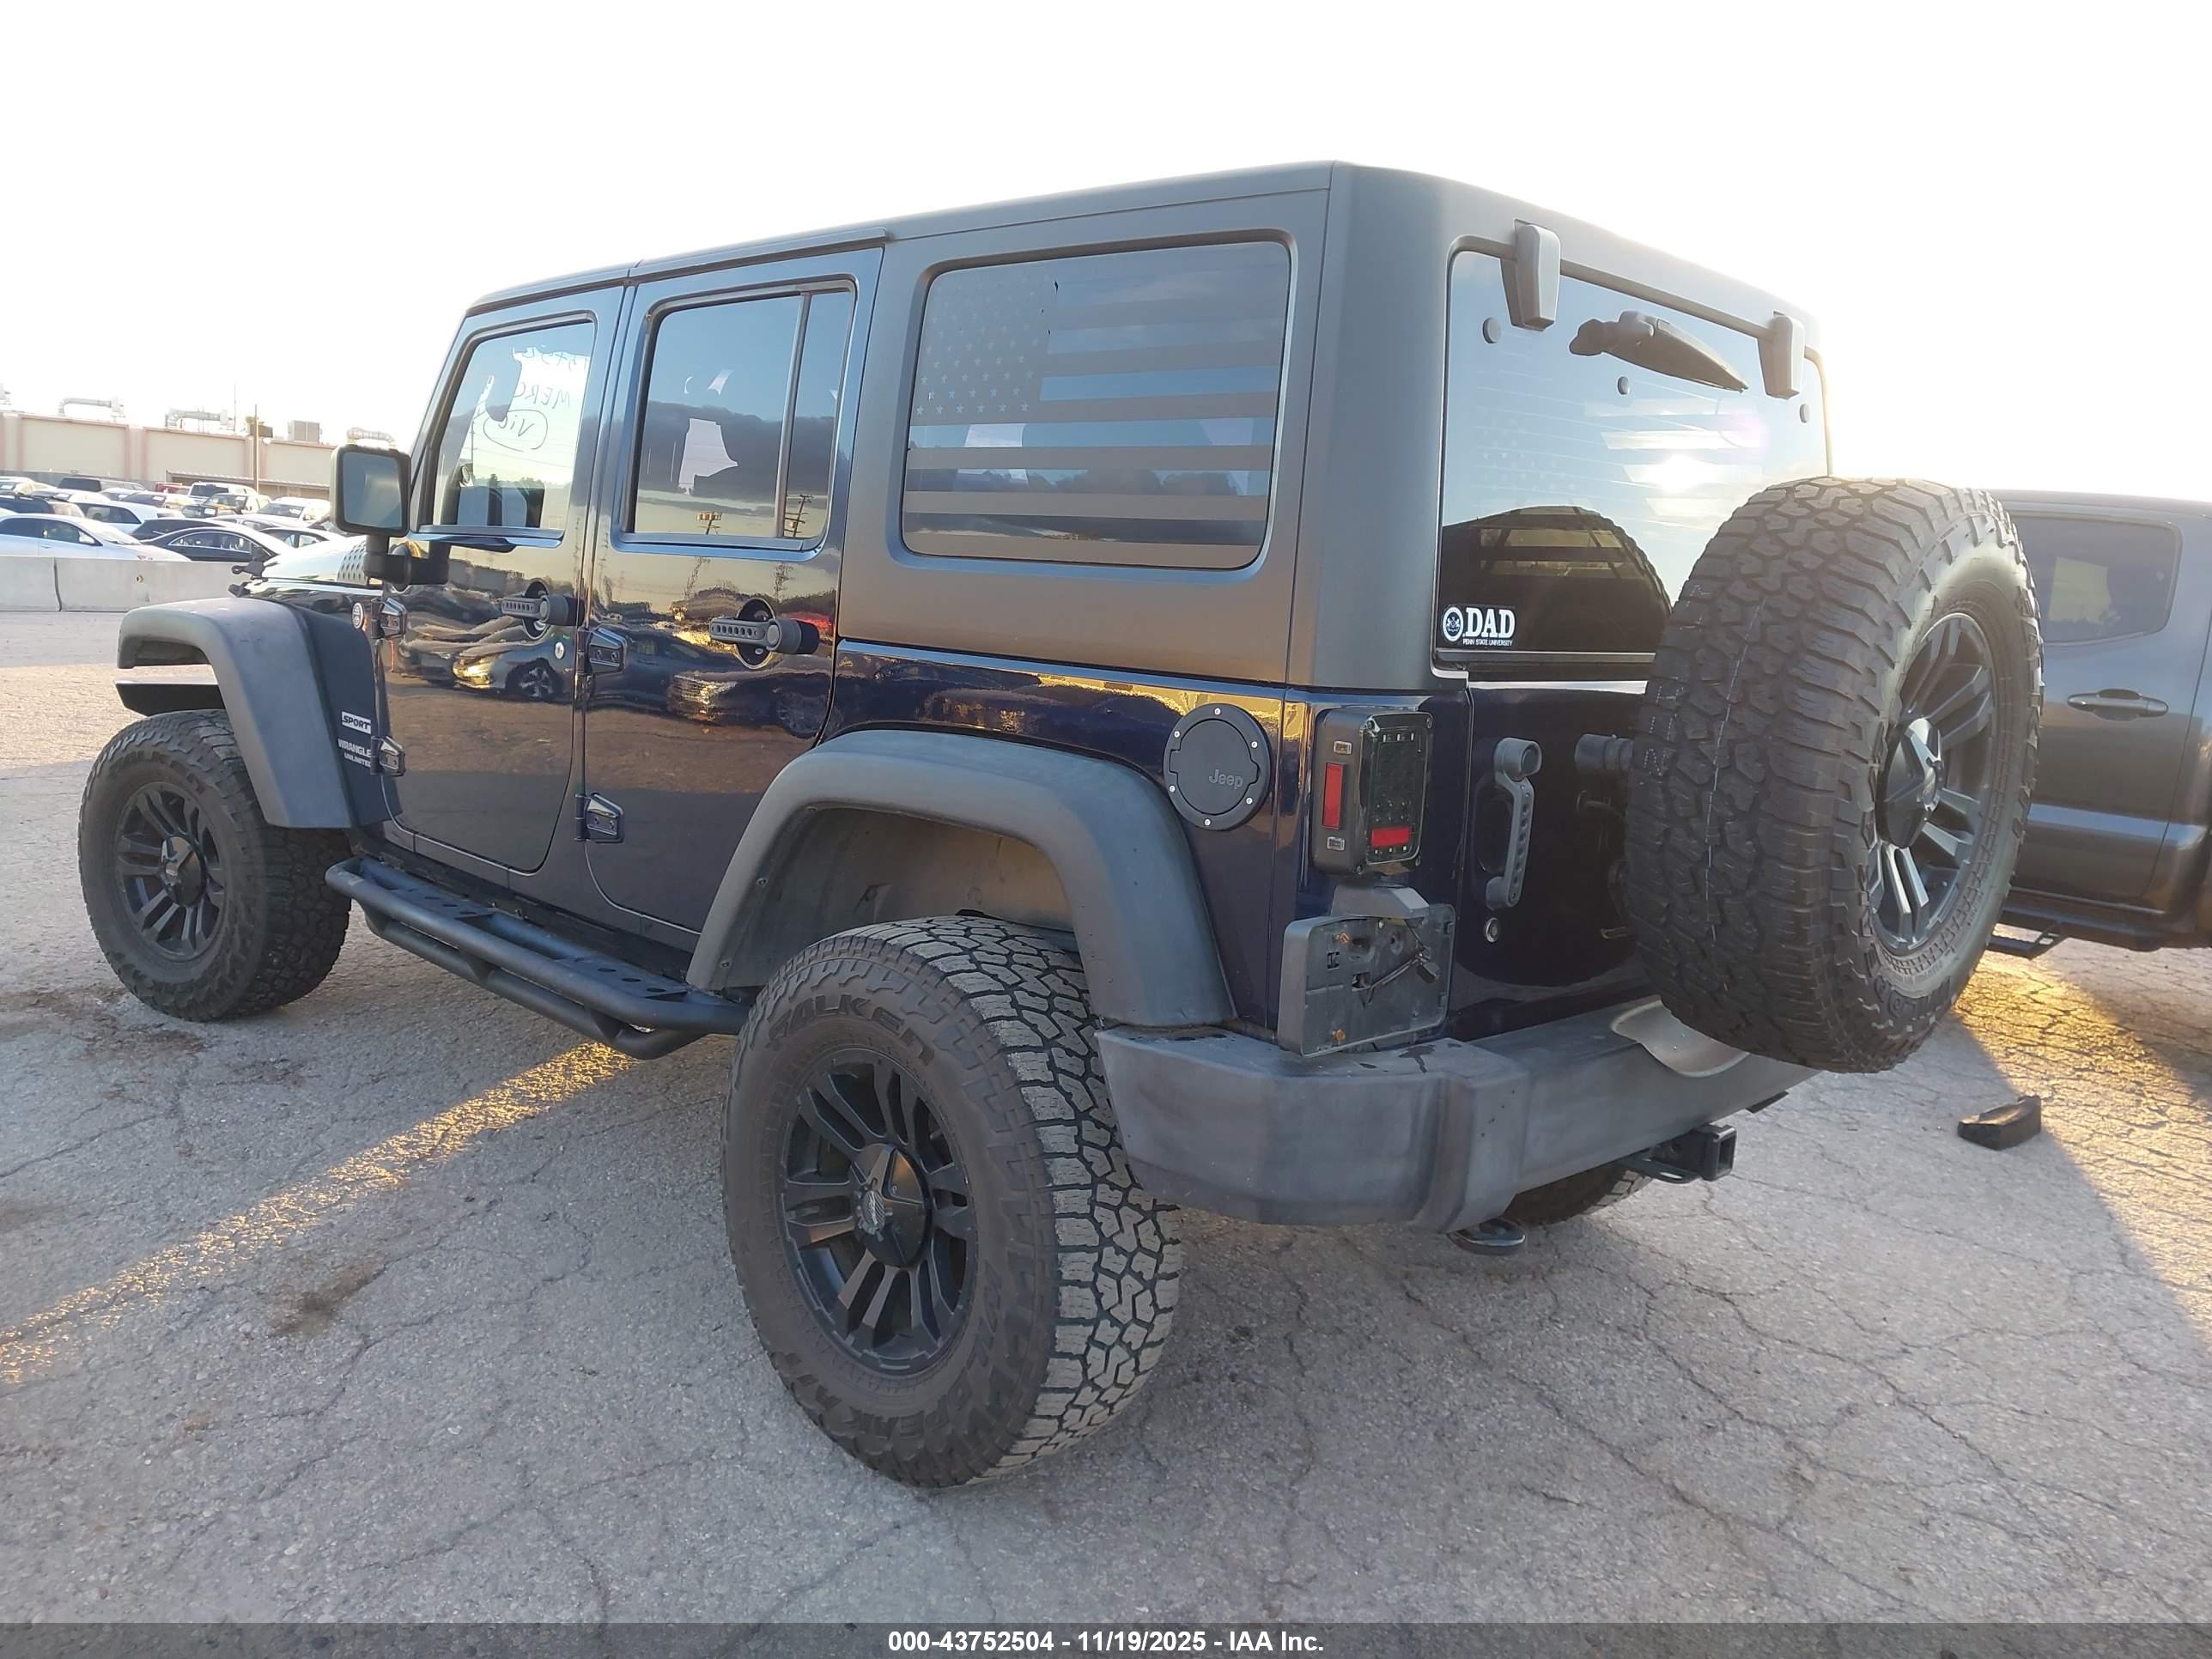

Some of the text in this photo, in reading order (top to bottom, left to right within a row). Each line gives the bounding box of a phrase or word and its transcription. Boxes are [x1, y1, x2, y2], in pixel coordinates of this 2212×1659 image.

[1465, 606, 1516, 639] DAD
[343, 714, 371, 730] SPORT
[337, 738, 372, 757] WRANGLE
[1208, 769, 1243, 790] Jeep
